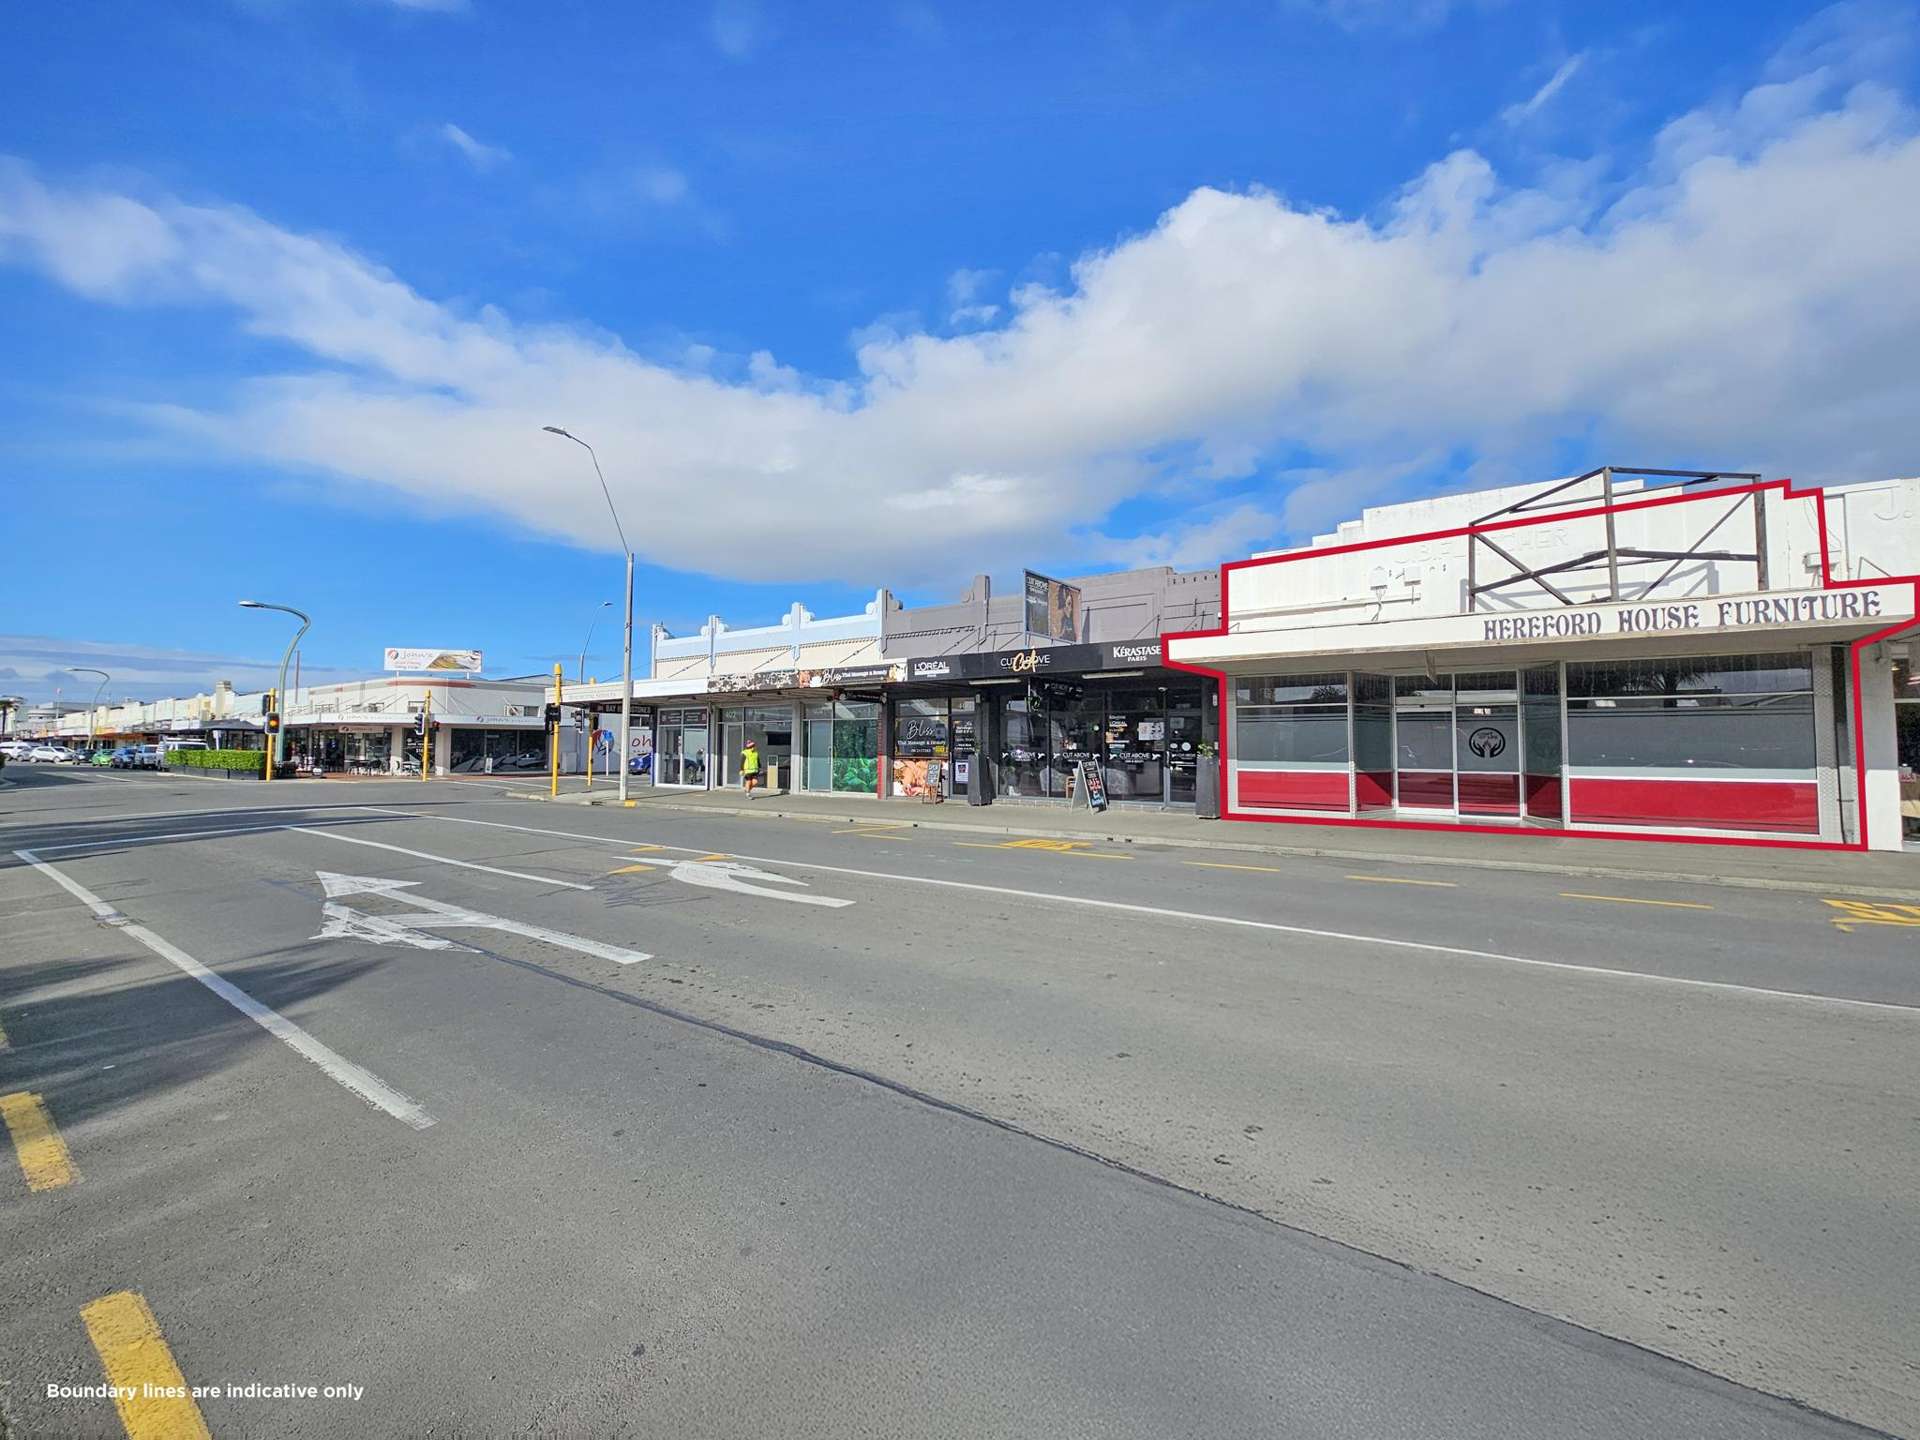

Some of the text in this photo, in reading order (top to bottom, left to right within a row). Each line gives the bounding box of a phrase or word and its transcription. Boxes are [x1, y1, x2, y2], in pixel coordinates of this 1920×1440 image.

[1483, 591, 1881, 641] HEREFORD HOUSE FURNITURE
[1113, 645, 1162, 658] KÉRASTASE
[914, 661, 949, 671] L'ORÉAL
[1119, 752, 1131, 760] CUT
